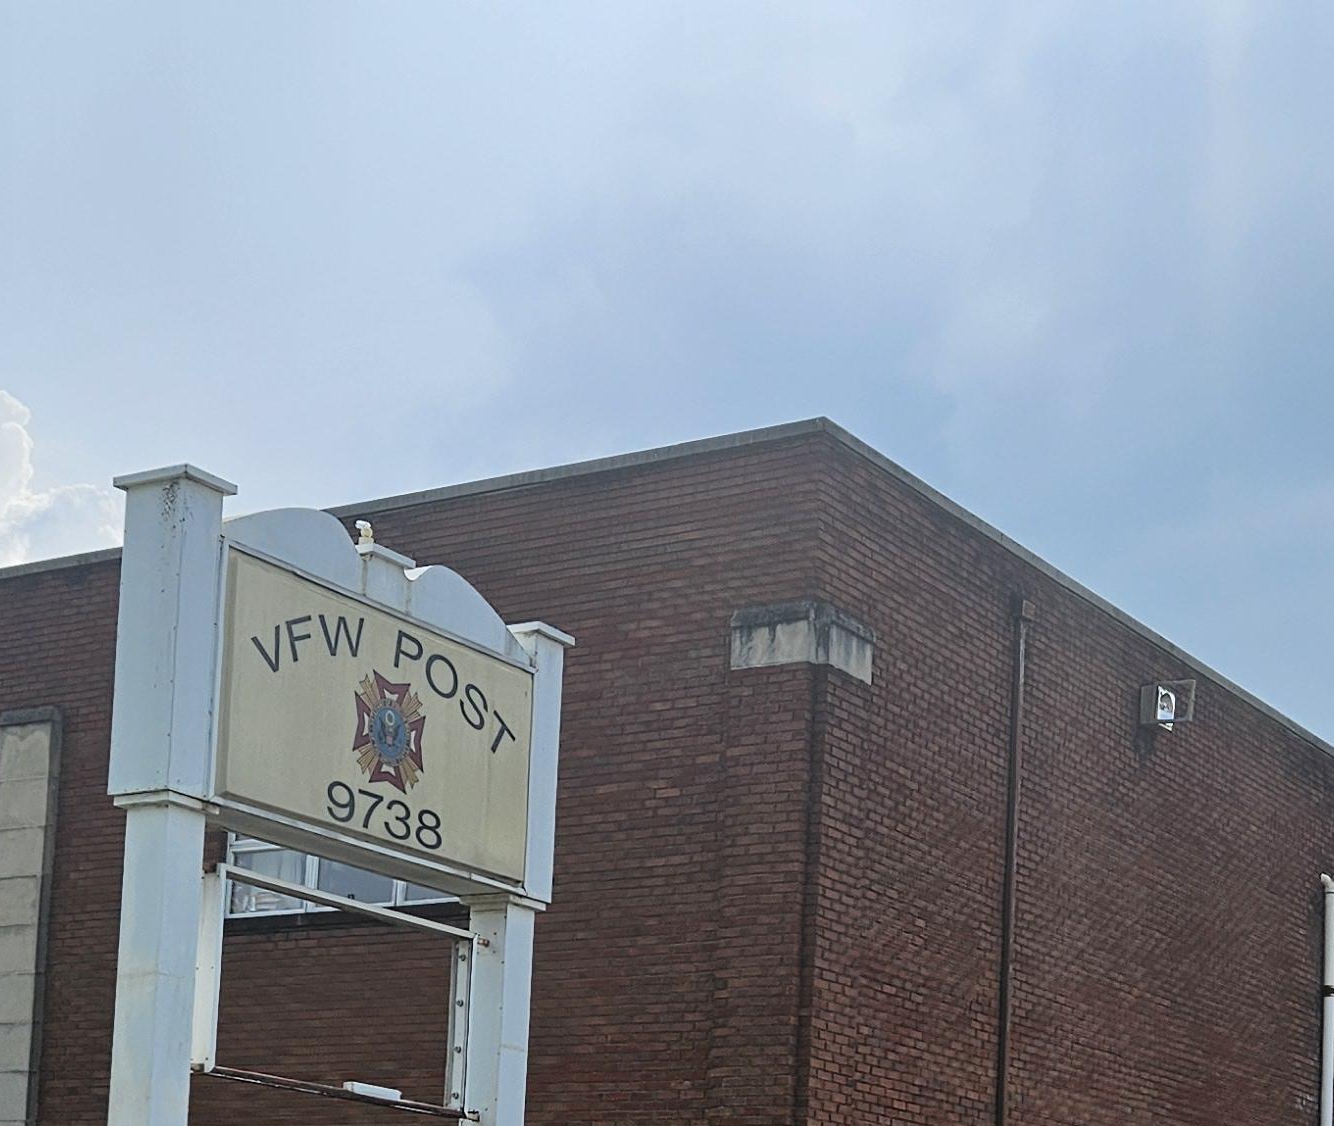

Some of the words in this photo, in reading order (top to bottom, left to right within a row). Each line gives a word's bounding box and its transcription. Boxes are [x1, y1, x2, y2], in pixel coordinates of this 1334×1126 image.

[251, 614, 365, 673] VFW
[393, 629, 516, 754] POST
[326, 780, 443, 851] 9738
